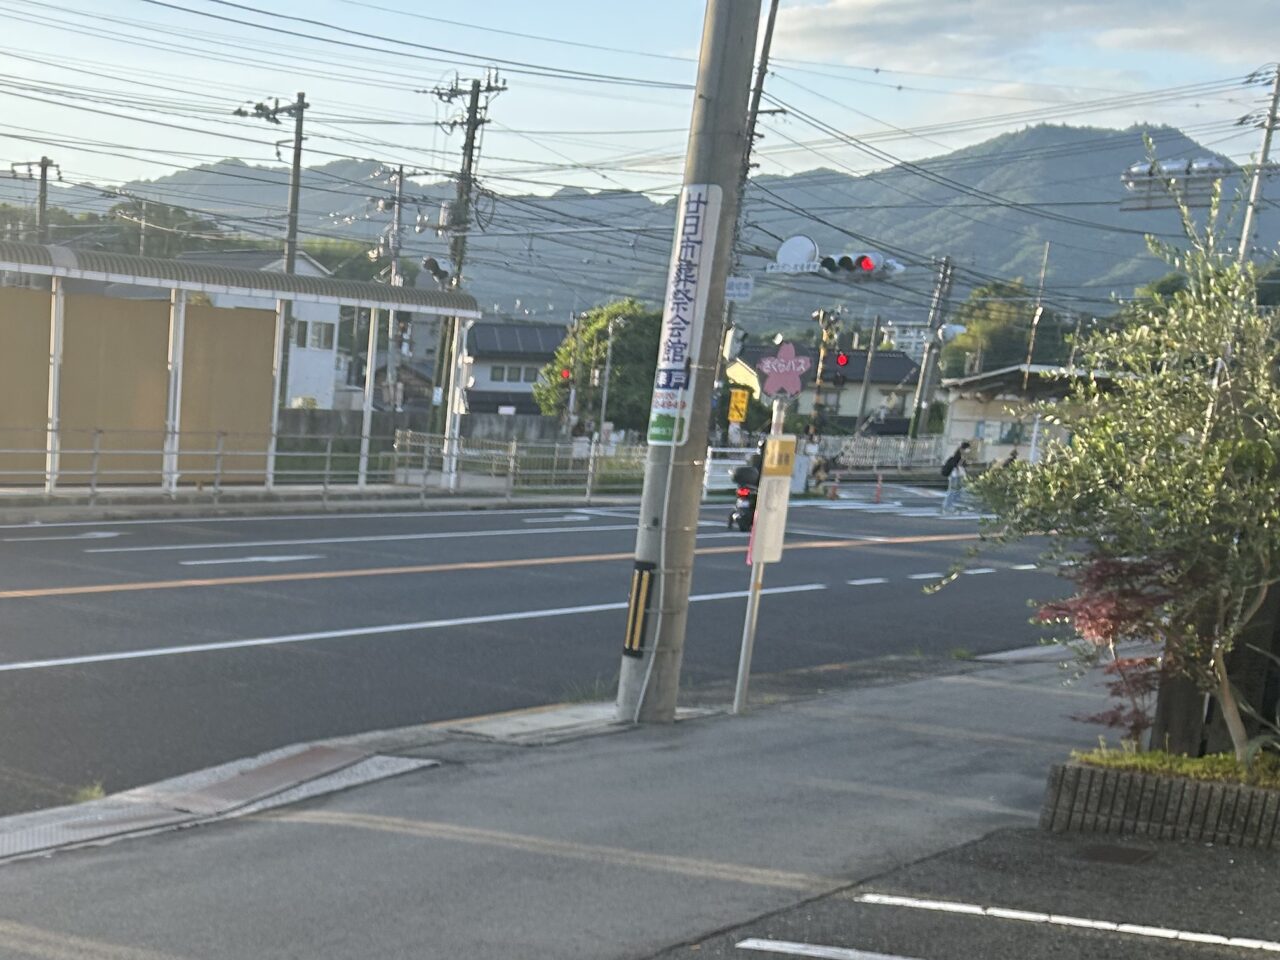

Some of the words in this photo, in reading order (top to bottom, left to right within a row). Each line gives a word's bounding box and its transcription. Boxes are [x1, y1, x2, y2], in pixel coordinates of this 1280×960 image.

[663, 192, 708, 363] 廿日市葬祭会館
[761, 358, 806, 373] さくらバス
